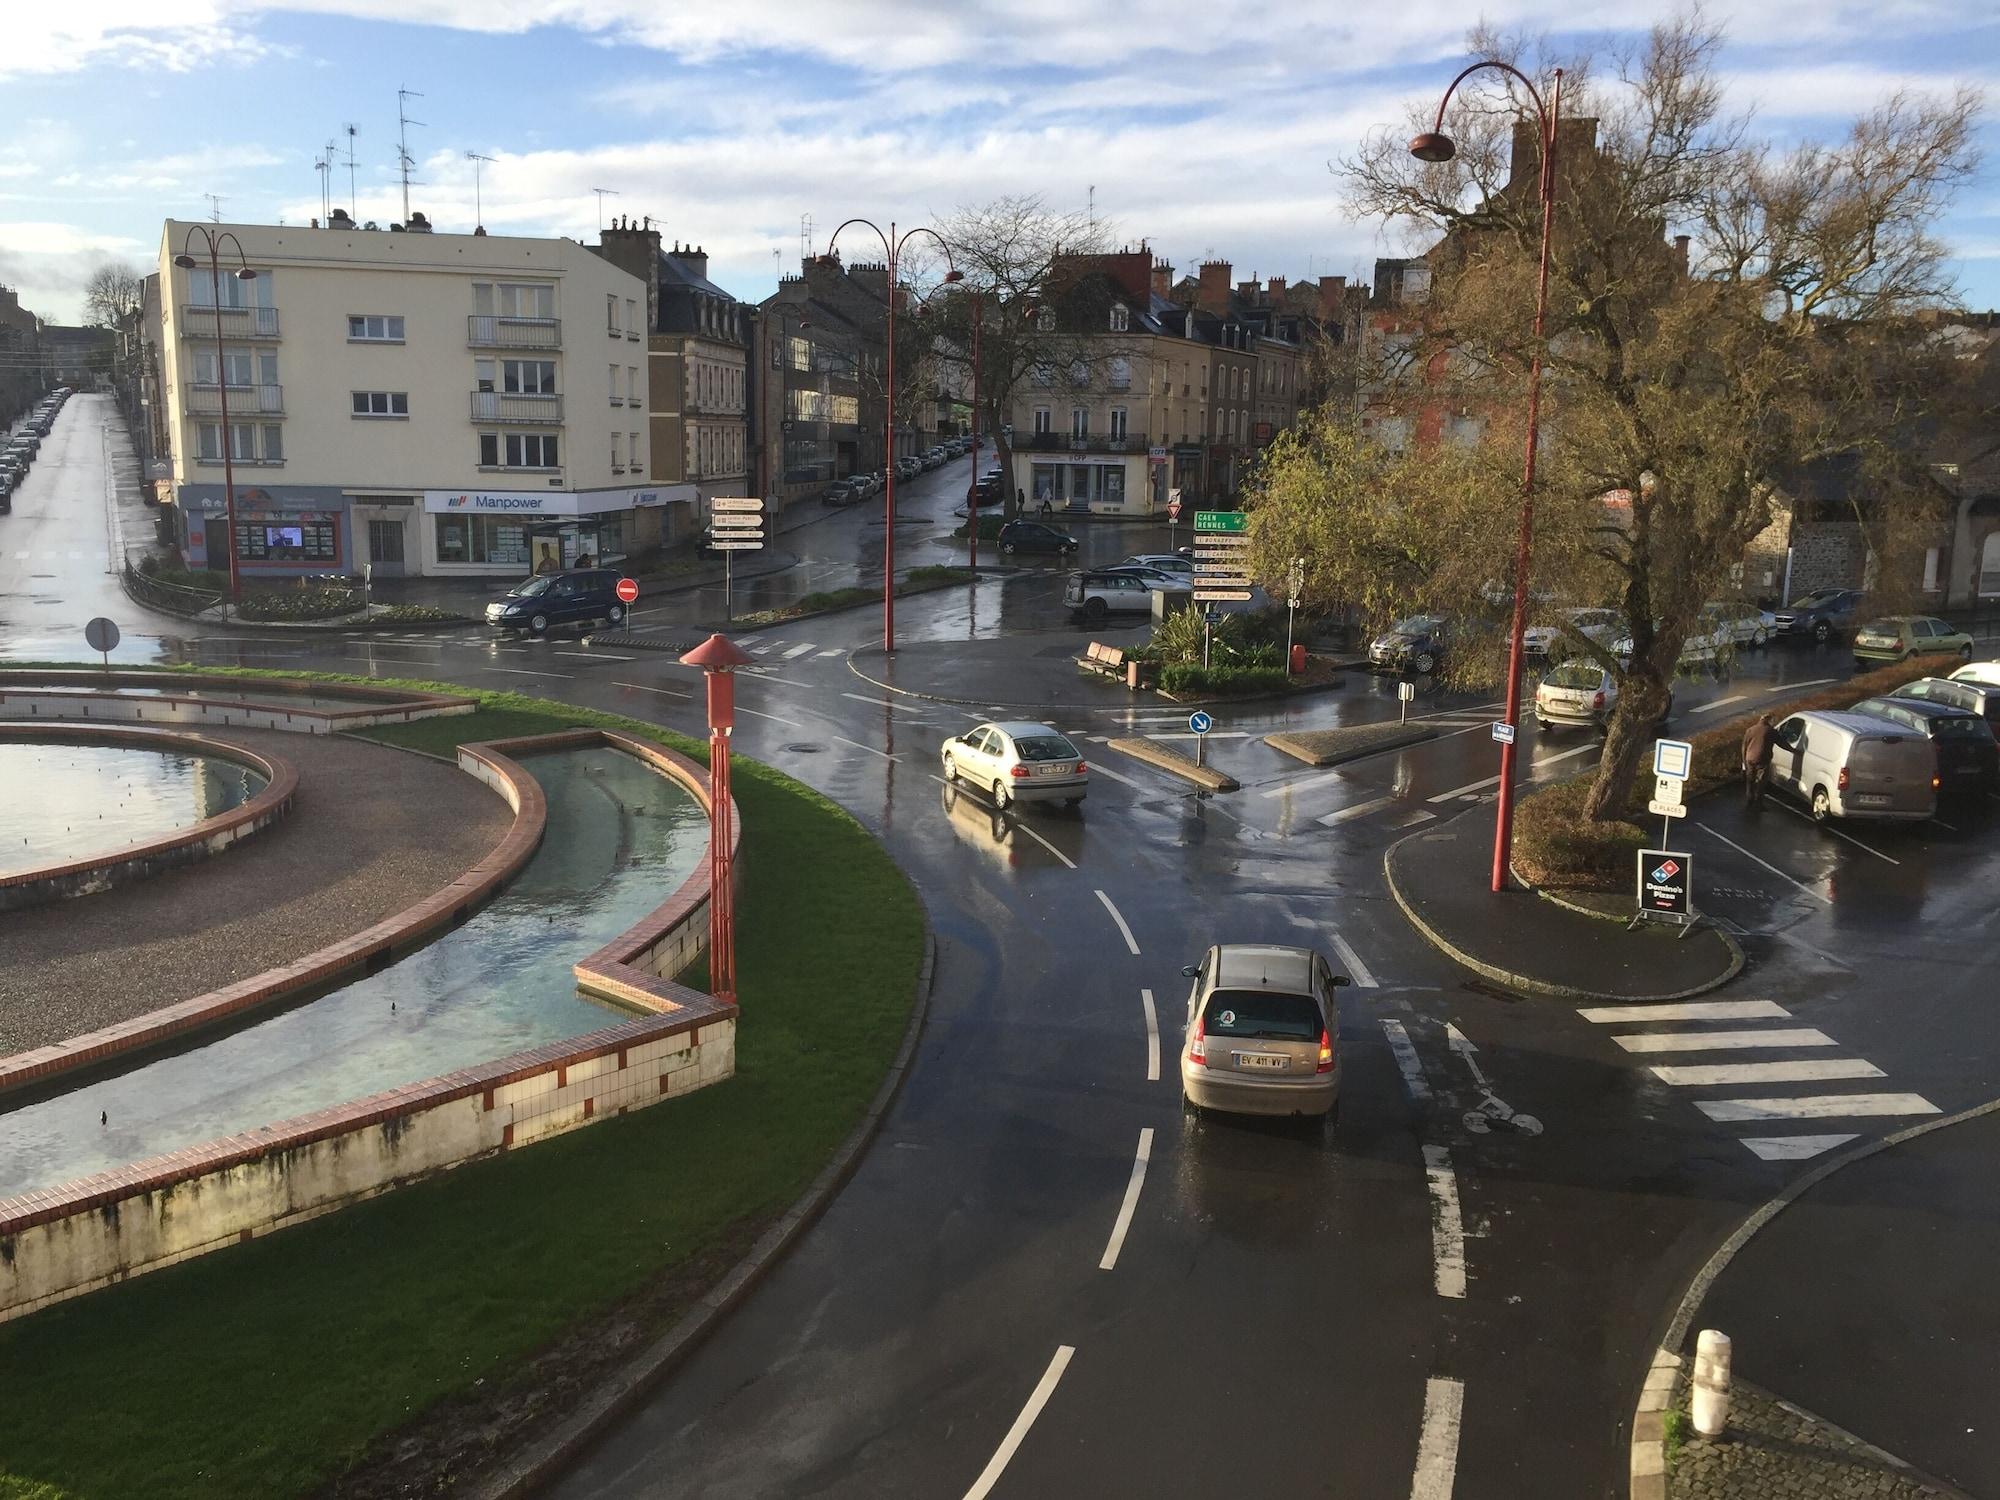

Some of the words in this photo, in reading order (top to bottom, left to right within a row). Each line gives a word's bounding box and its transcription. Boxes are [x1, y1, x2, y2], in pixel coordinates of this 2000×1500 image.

[476, 495, 543, 509] Manpower
[1646, 882, 1684, 894] Domino's
[1653, 890, 1676, 900] Pizza
